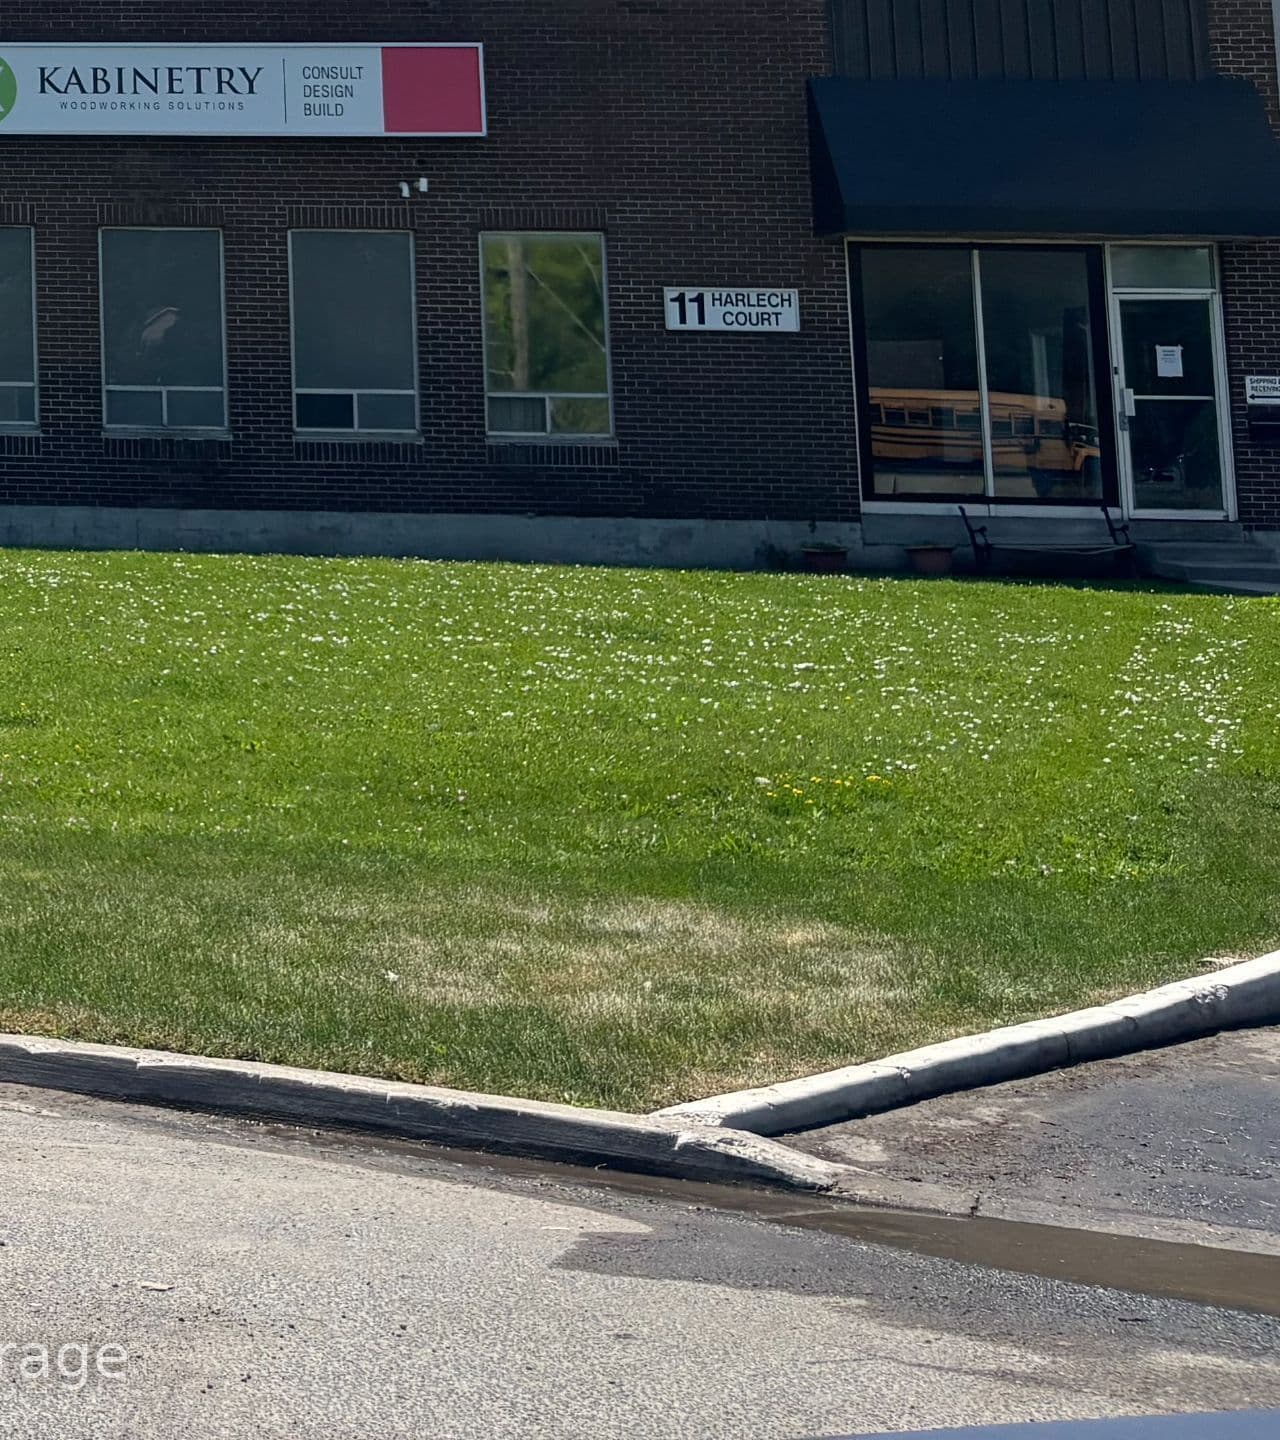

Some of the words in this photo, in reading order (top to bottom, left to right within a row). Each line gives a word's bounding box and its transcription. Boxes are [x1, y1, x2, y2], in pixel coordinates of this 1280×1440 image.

[302, 65, 364, 80] CONSULT
[36, 65, 265, 96] KABINETRY
[303, 84, 354, 98] DESIGN
[58, 100, 162, 111] WOODWORKING
[168, 100, 245, 111] SOLUTIONS
[303, 103, 345, 117] BUILD
[711, 292, 792, 308] HARLECH
[669, 291, 707, 326] 11
[722, 310, 783, 327] COURT
